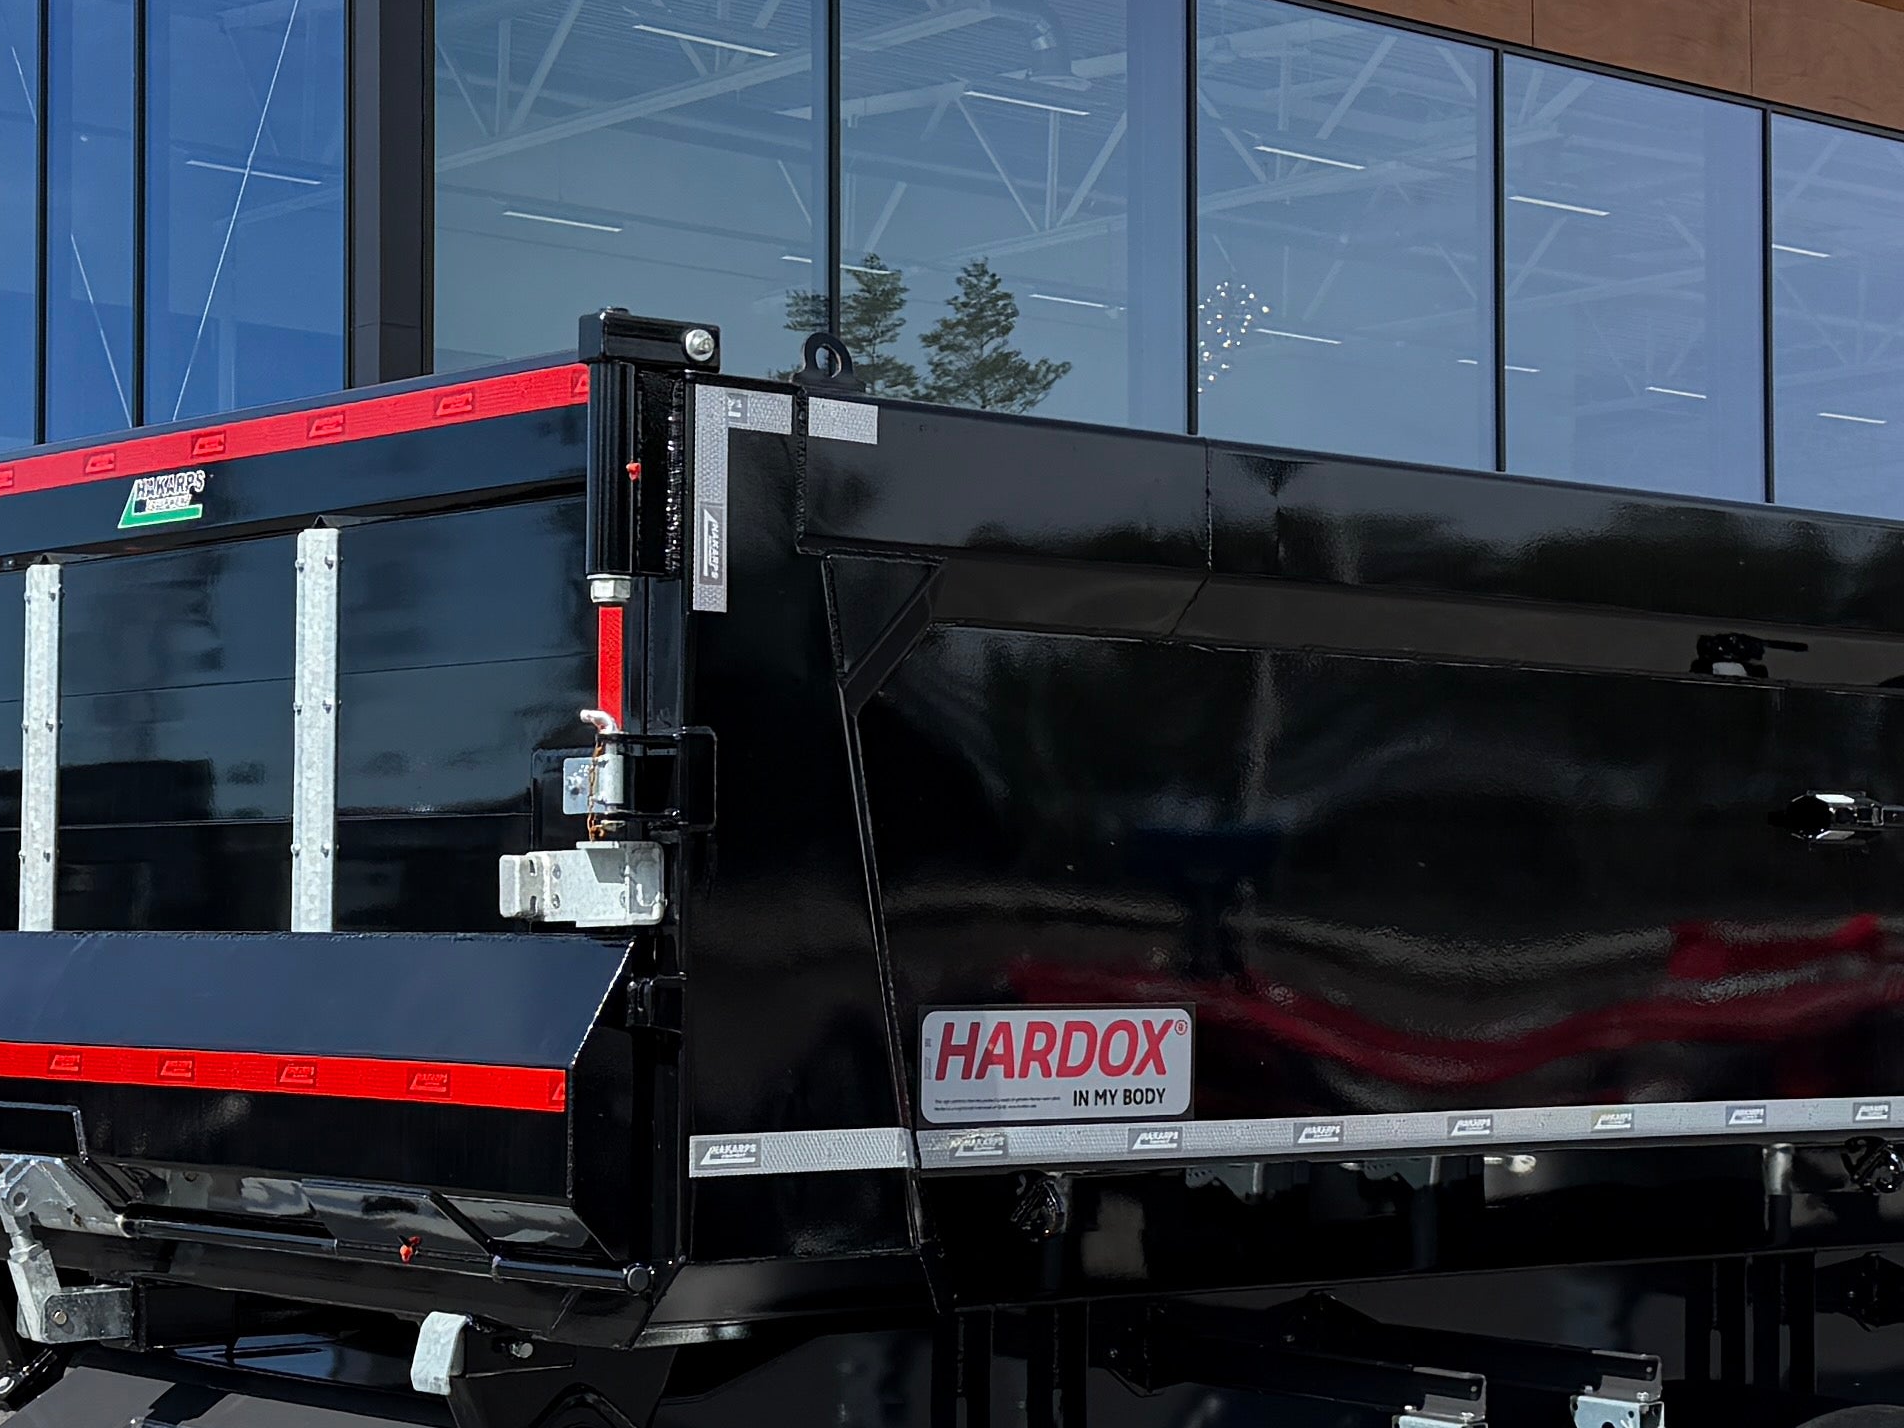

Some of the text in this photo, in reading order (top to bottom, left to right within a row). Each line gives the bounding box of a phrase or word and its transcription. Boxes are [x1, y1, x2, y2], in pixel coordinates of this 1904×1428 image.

[136, 469, 206, 499] HAKARPS
[1073, 1089, 1089, 1107] IN
[1095, 1088, 1118, 1106] MY
[1123, 1088, 1166, 1105] BODY
